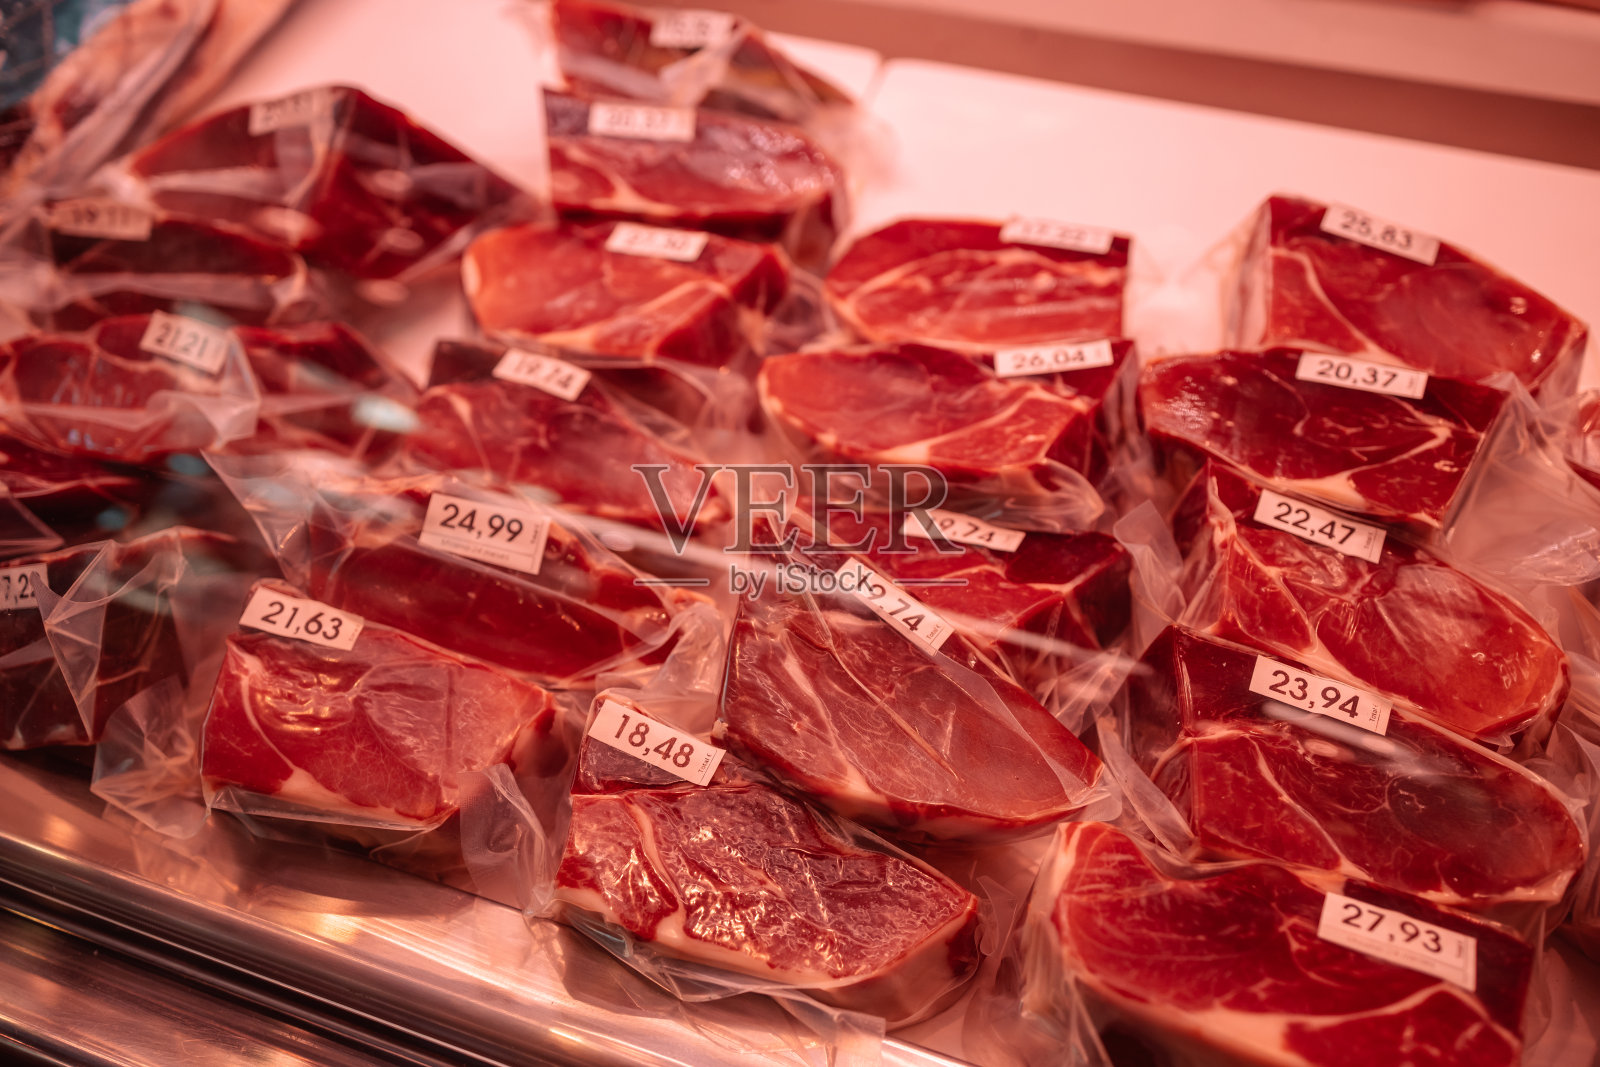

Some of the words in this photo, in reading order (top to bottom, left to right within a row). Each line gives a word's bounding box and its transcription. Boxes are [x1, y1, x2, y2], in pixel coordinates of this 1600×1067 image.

[1341, 210, 1413, 250] 25,83
[1012, 350, 1085, 371] 26,04
[1317, 359, 1398, 388] 20,37
[440, 503, 523, 542] 24,99
[1273, 502, 1356, 545] 22,47
[261, 601, 343, 640] 21,63
[1269, 669, 1360, 719] 23,94
[614, 713, 695, 768] 18,48
[1341, 903, 1442, 953] 27,93
